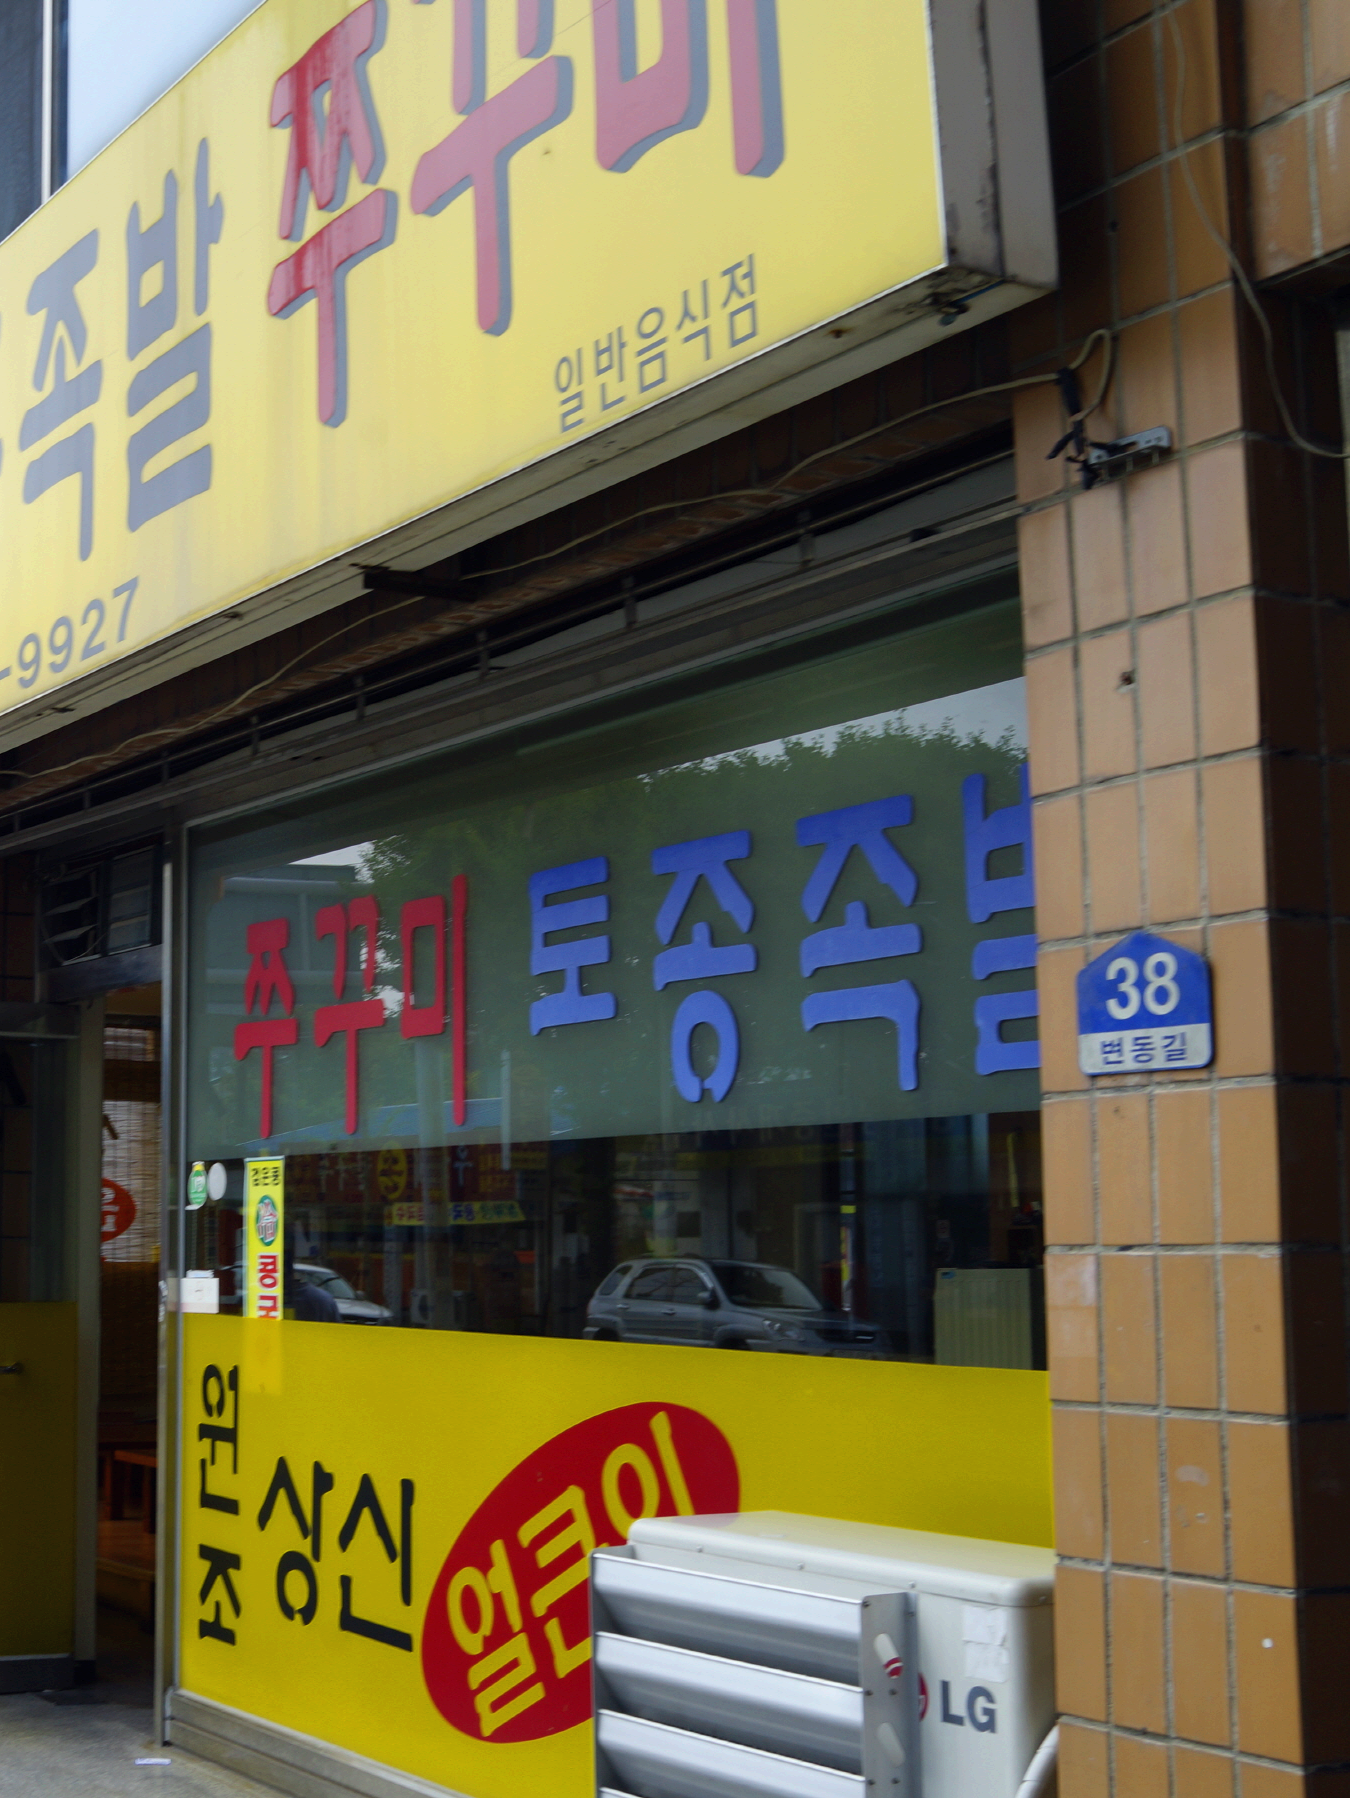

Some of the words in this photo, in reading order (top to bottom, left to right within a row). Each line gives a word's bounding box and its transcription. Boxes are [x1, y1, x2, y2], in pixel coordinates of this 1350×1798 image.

[553, 253, 760, 434] 일반음식점
[234, 874, 468, 1138] 쭈꾸미
[1105, 952, 1181, 1020] 38
[1100, 1031, 1188, 1066] 변동길
[198, 1363, 242, 1646] 원조
[256, 1456, 416, 1652] 상신
[447, 1410, 696, 1738] 얼큰이
[939, 1679, 998, 1735] LG
